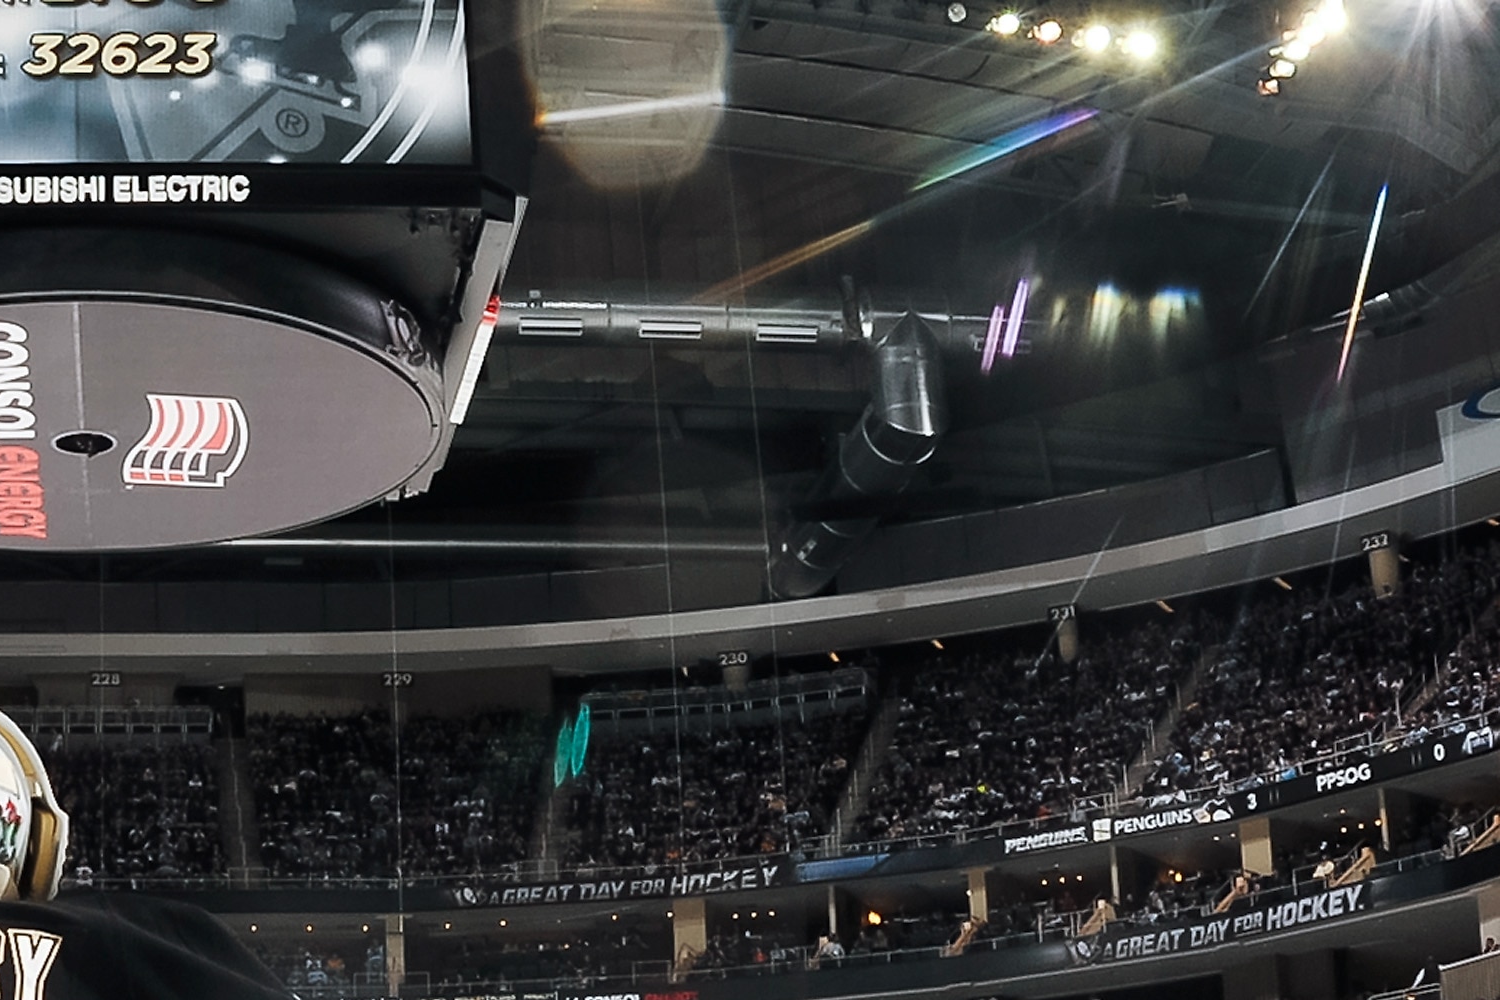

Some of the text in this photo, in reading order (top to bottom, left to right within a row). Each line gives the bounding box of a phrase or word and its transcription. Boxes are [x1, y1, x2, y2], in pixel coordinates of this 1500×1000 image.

[20, 31, 217, 77] 32623
[112, 174, 251, 204] ELECTRIC
[719, 651, 748, 666] 230
[91, 673, 121, 686] 228
[383, 673, 413, 687] 229
[1316, 762, 1372, 792] PPSOG
[1433, 743, 1445, 761] 0
[1114, 793, 1258, 835] PENGUINS 3
[501, 884, 574, 905] GREAT
[579, 881, 625, 902] DAY
[630, 878, 665, 896] FOR
[1115, 928, 1186, 960] GREAT
[1189, 918, 1231, 948] DAY
[1233, 911, 1263, 934] FOR
[1266, 884, 1366, 932] HOCKEY.
